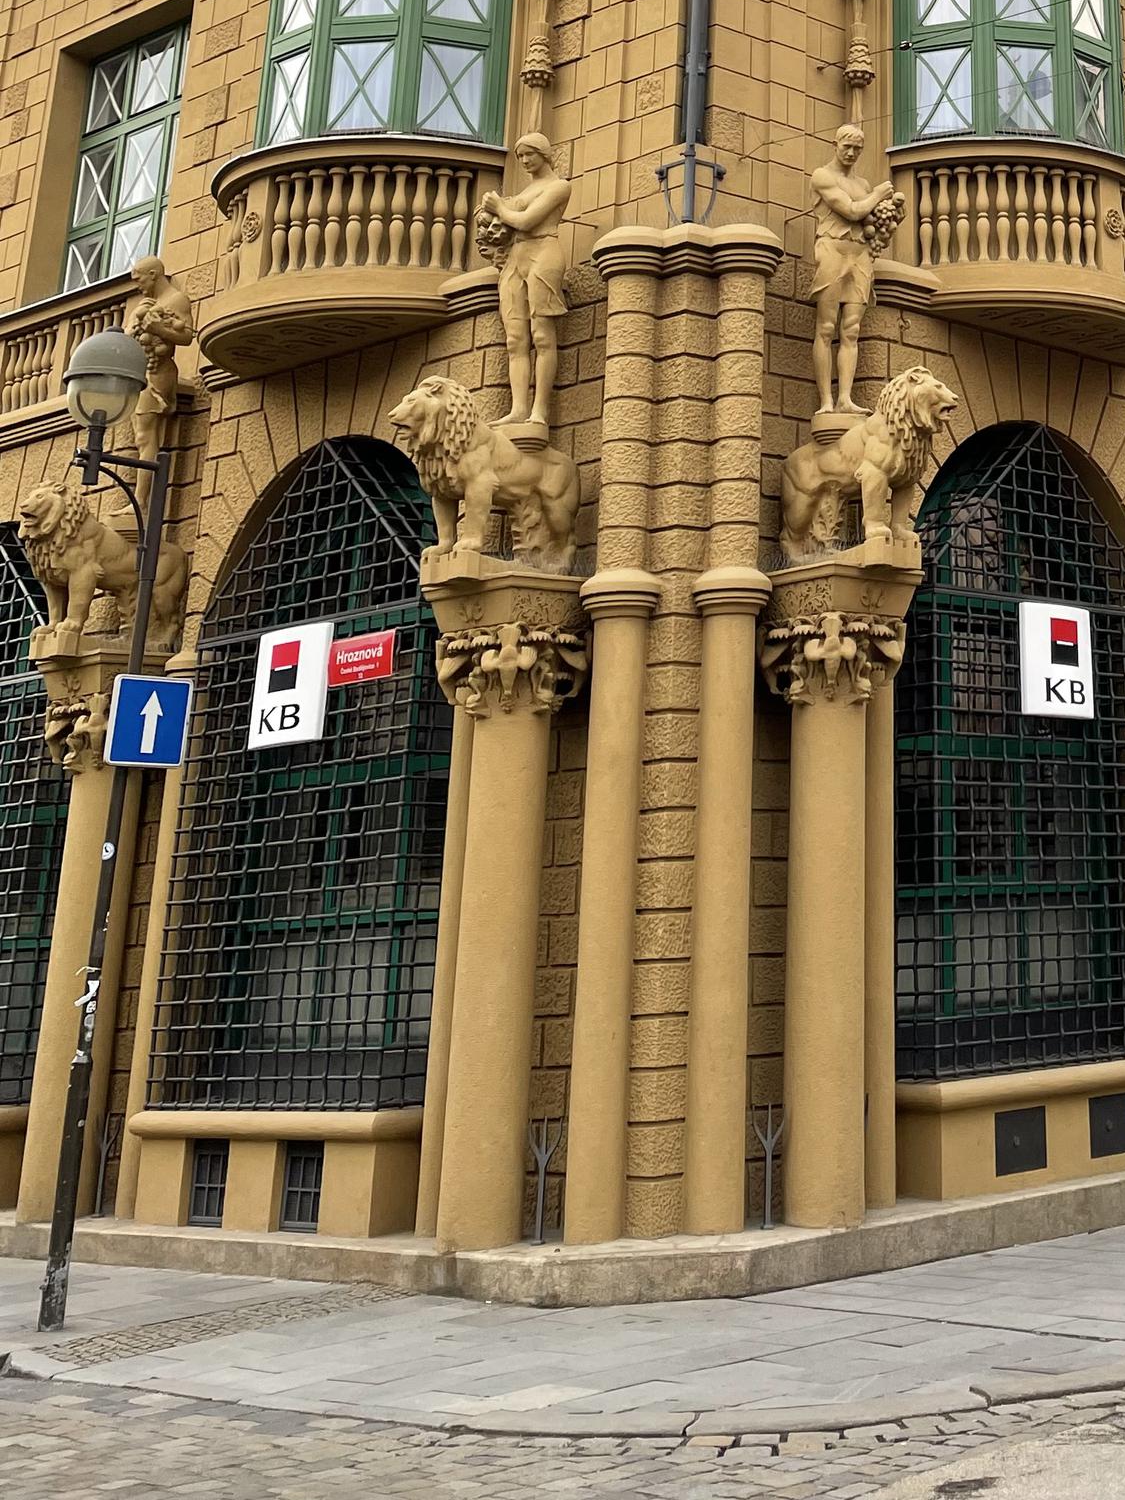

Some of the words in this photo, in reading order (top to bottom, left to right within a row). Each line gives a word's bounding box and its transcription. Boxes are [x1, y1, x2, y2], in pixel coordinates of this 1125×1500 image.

[336, 642, 383, 665] Hroznová
[1045, 677, 1085, 705] KB
[258, 703, 300, 734] KB
